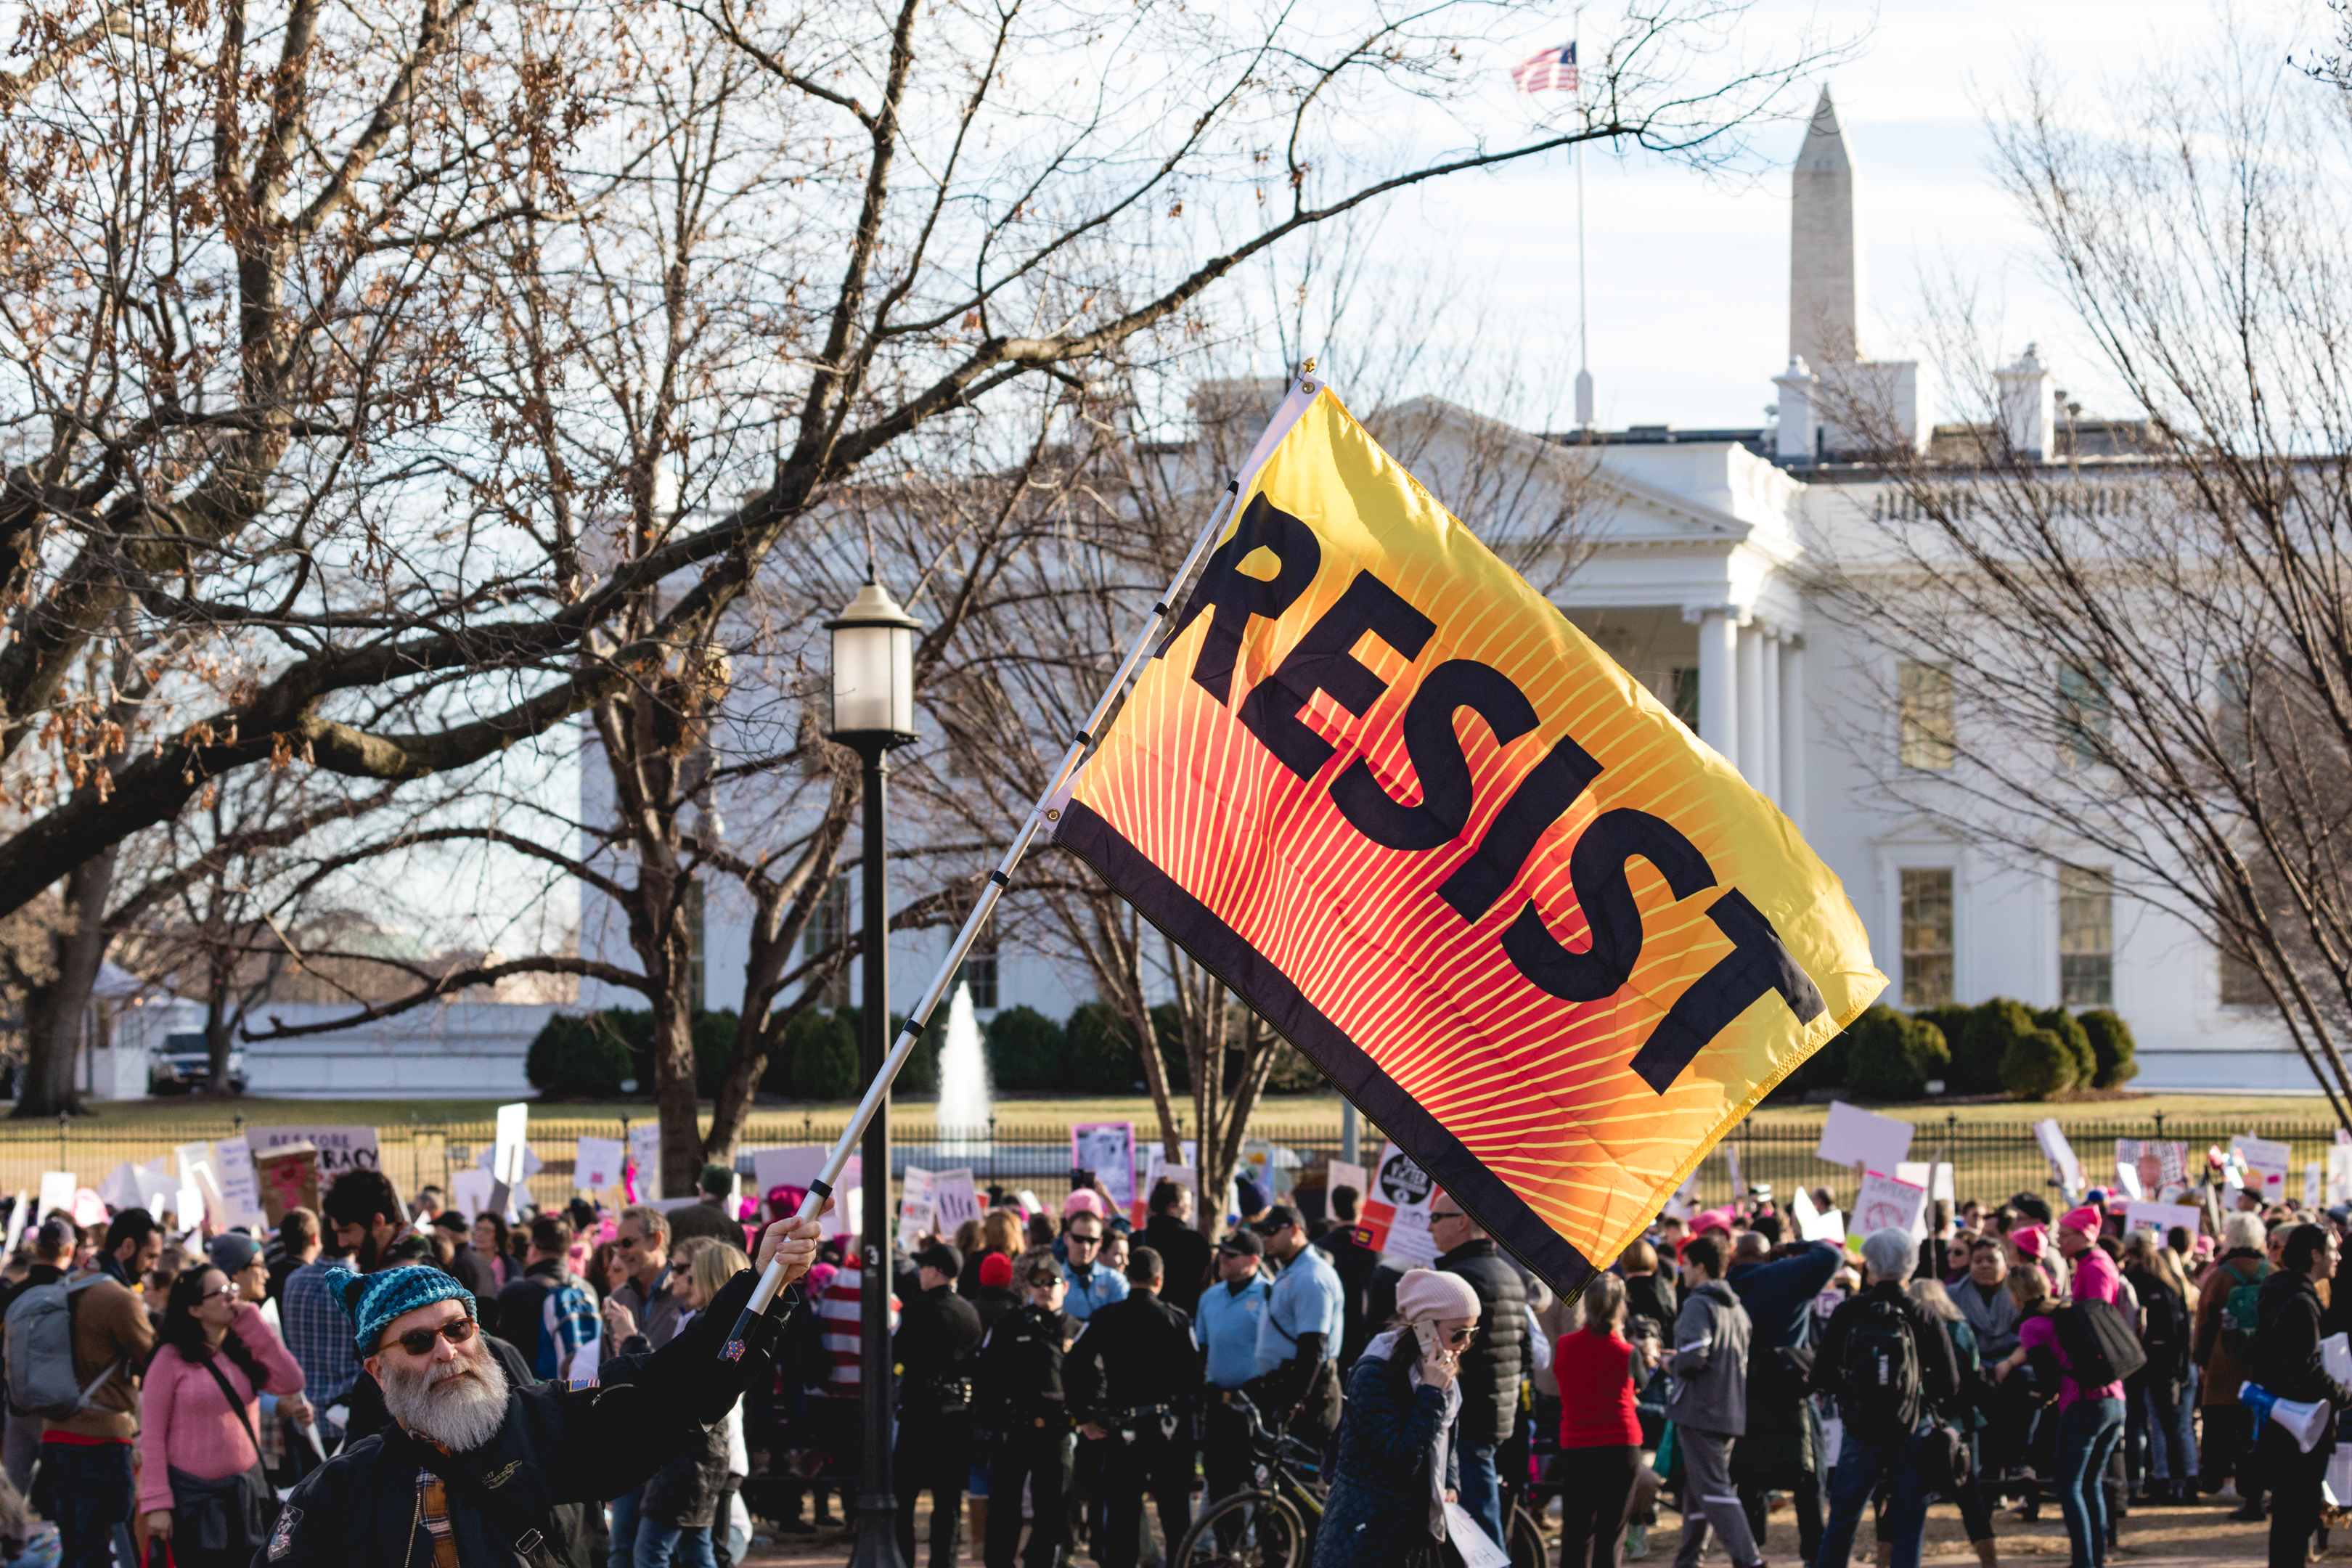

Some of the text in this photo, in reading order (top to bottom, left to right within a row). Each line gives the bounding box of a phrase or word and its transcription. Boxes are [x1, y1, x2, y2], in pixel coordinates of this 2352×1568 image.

[1153, 490, 1827, 1096] RESIST
[317, 1148, 378, 1169] RACY
[481, 1471, 494, 1483] C-17
